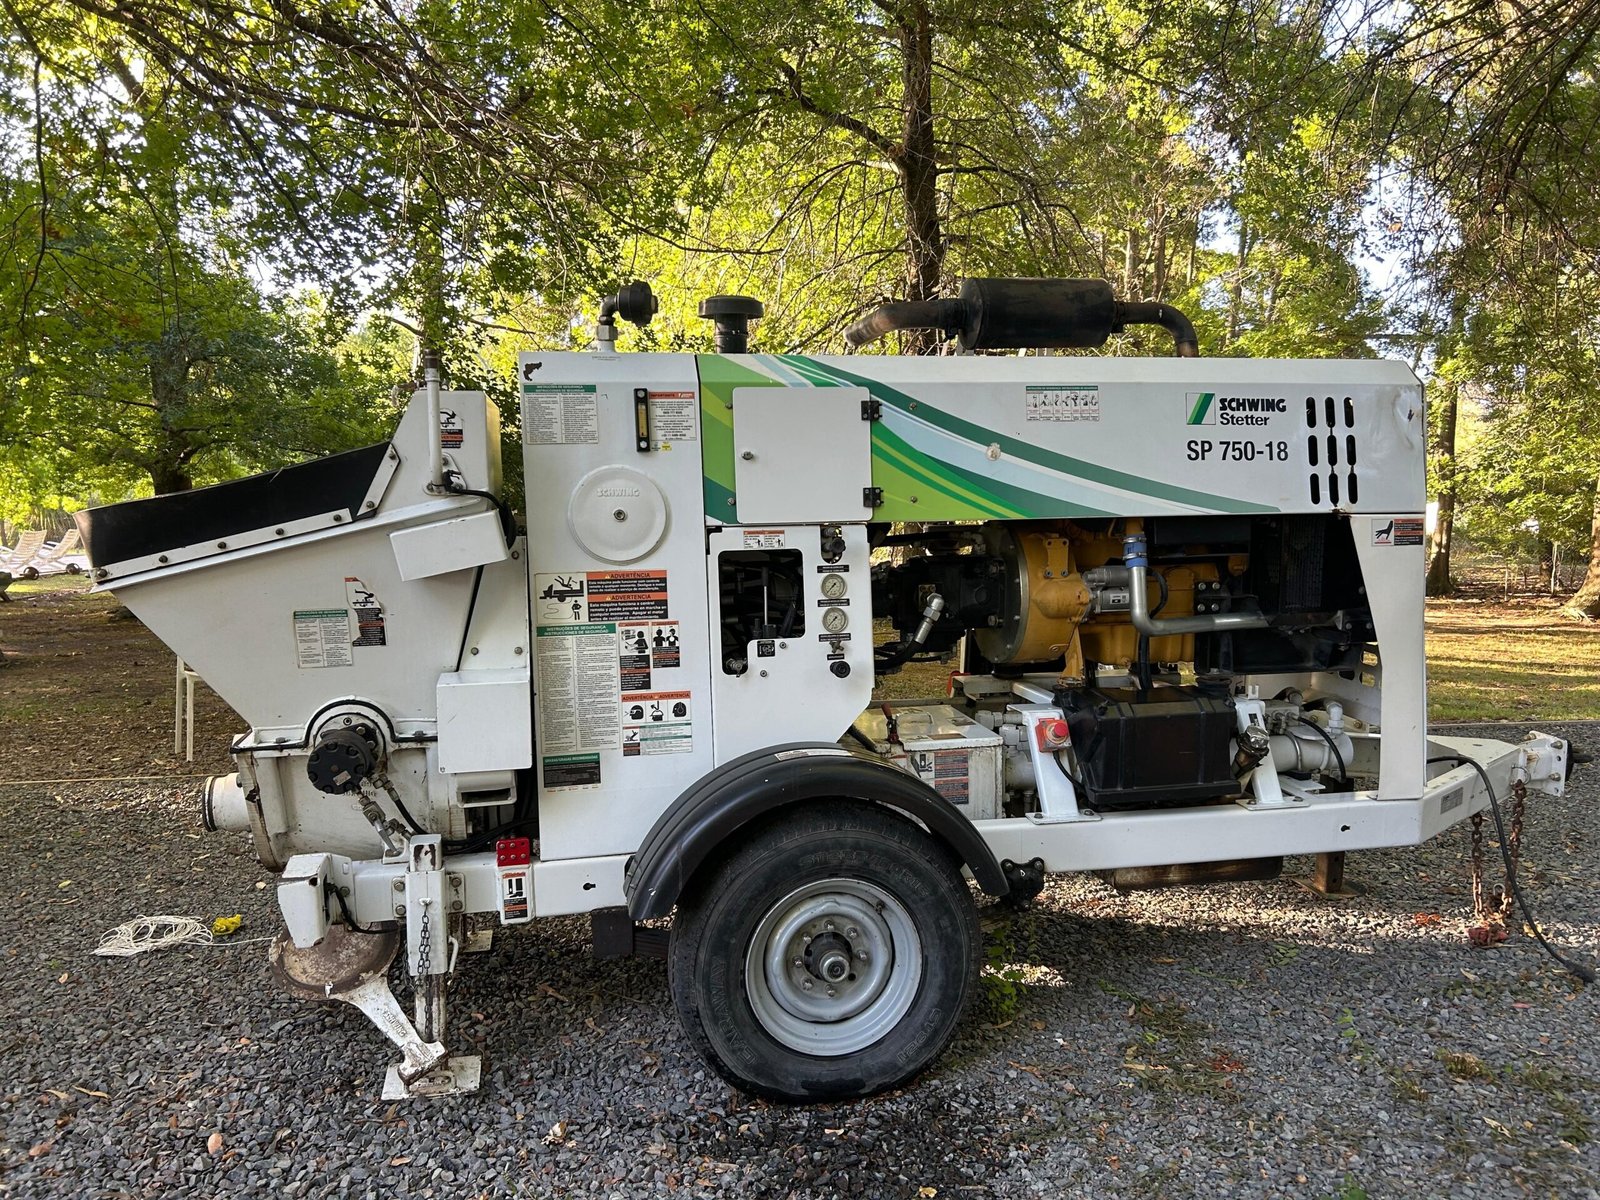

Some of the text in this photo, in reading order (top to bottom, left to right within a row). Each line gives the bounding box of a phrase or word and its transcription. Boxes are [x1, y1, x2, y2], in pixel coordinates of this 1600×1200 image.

[1219, 398, 1286, 412] SCHWING
[1220, 412, 1270, 426] Stetter
[1186, 440, 1288, 461] SP 750-18
[597, 488, 640, 497] SCHWING
